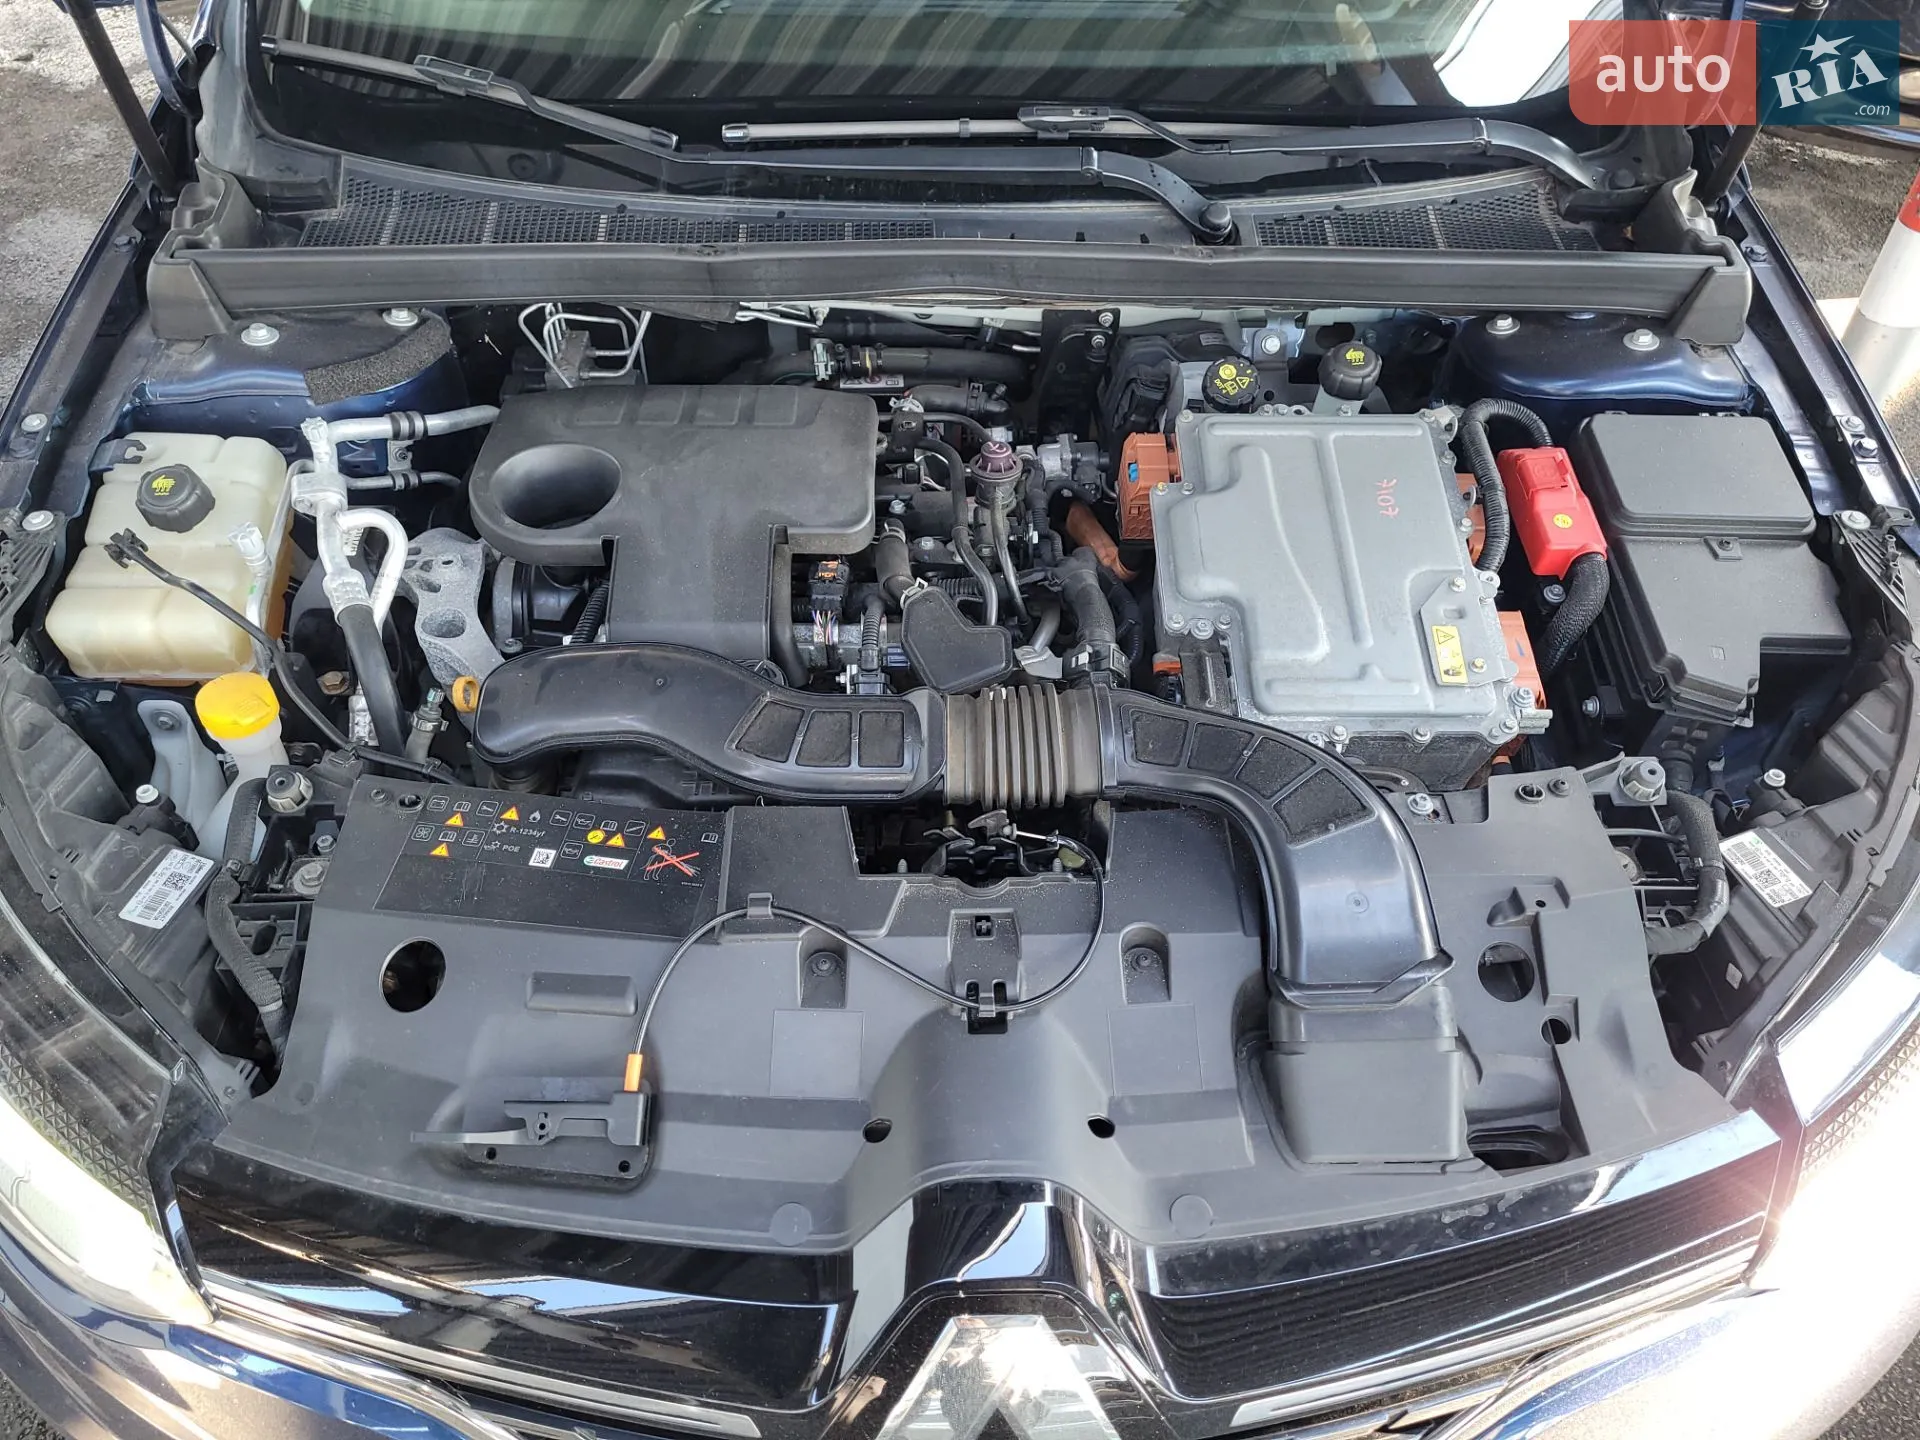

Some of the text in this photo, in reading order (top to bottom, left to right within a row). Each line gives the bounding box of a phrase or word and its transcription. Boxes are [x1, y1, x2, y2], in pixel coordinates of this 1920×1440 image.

[1214, 378, 1225, 389] DOT
[509, 826, 546, 838] R-1234yf
[502, 844, 520, 853] POE
[593, 857, 623, 868] Castrol
